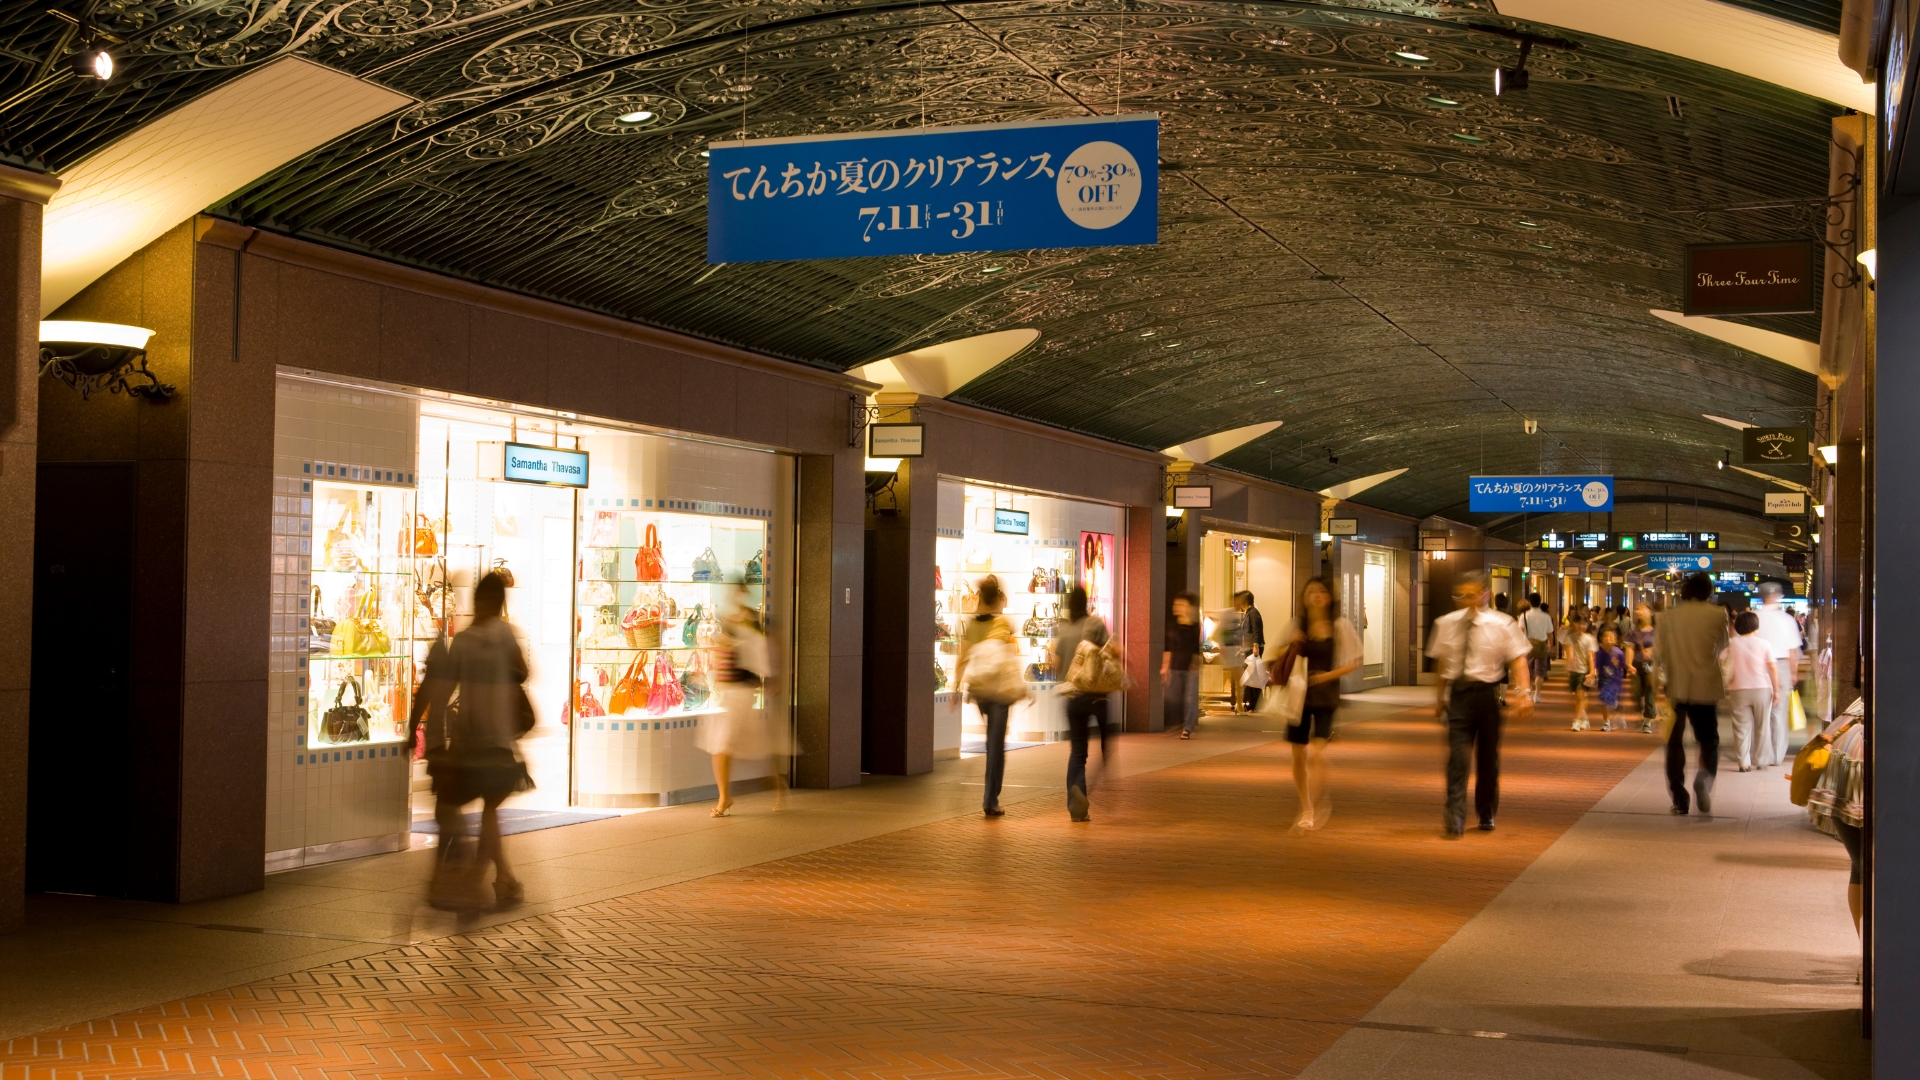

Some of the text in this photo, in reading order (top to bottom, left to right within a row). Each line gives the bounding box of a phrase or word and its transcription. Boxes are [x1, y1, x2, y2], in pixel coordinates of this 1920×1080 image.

[723, 152, 1055, 201] てんちか夏のクリアランス
[1078, 183, 1121, 204] OFF
[1697, 269, 1800, 287] Three Four Time
[511, 456, 581, 475] Samantha Thavasa
[1474, 482, 1583, 494] てんちか夏のクリアランス
[1231, 538, 1248, 554] SOUP
[50, 564, 66, 575] 074
